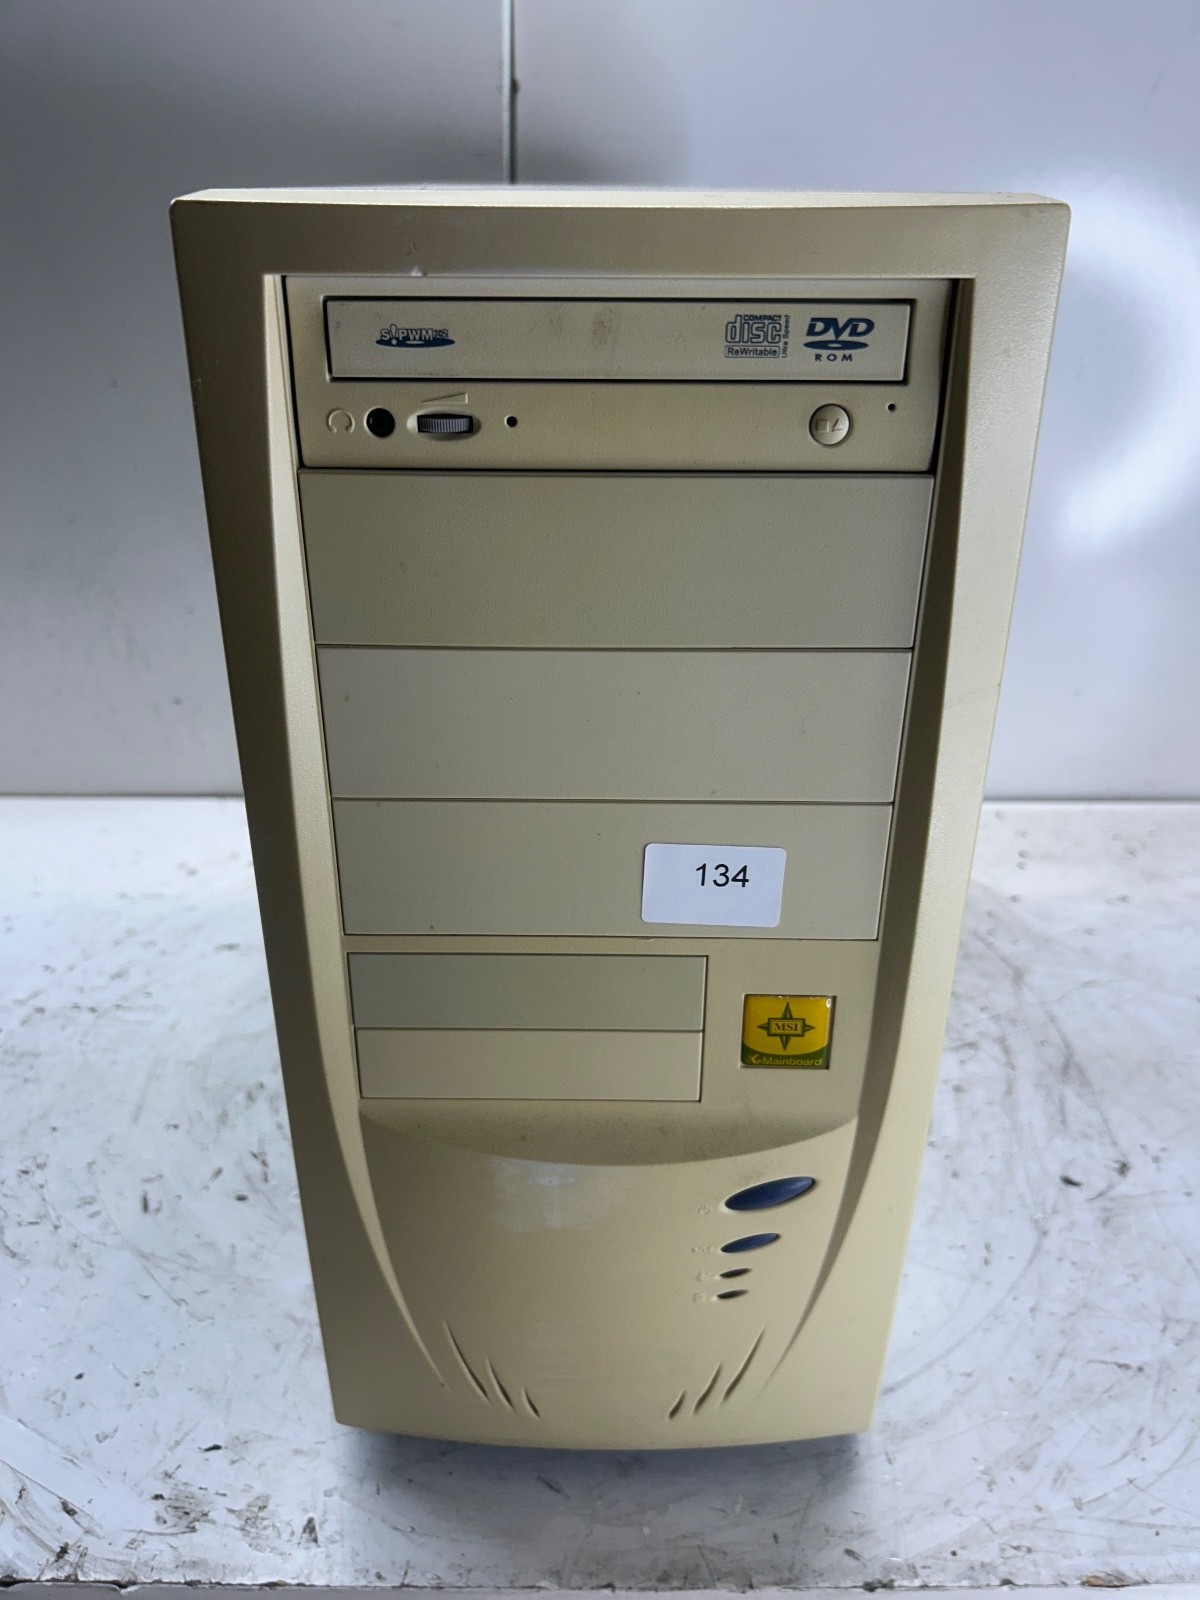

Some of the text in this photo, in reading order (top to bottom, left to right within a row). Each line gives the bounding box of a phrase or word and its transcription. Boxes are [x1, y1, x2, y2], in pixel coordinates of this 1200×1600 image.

[743, 314, 782, 322] COMPACT
[725, 314, 782, 344] disc
[805, 317, 875, 340] DVD
[781, 314, 791, 359] Ultra Speed
[727, 347, 778, 357] ReWritable
[814, 353, 853, 362] ROM
[695, 862, 750, 888] 134
[773, 1022, 799, 1032] MSI
[762, 1056, 822, 1066] Mainboard
